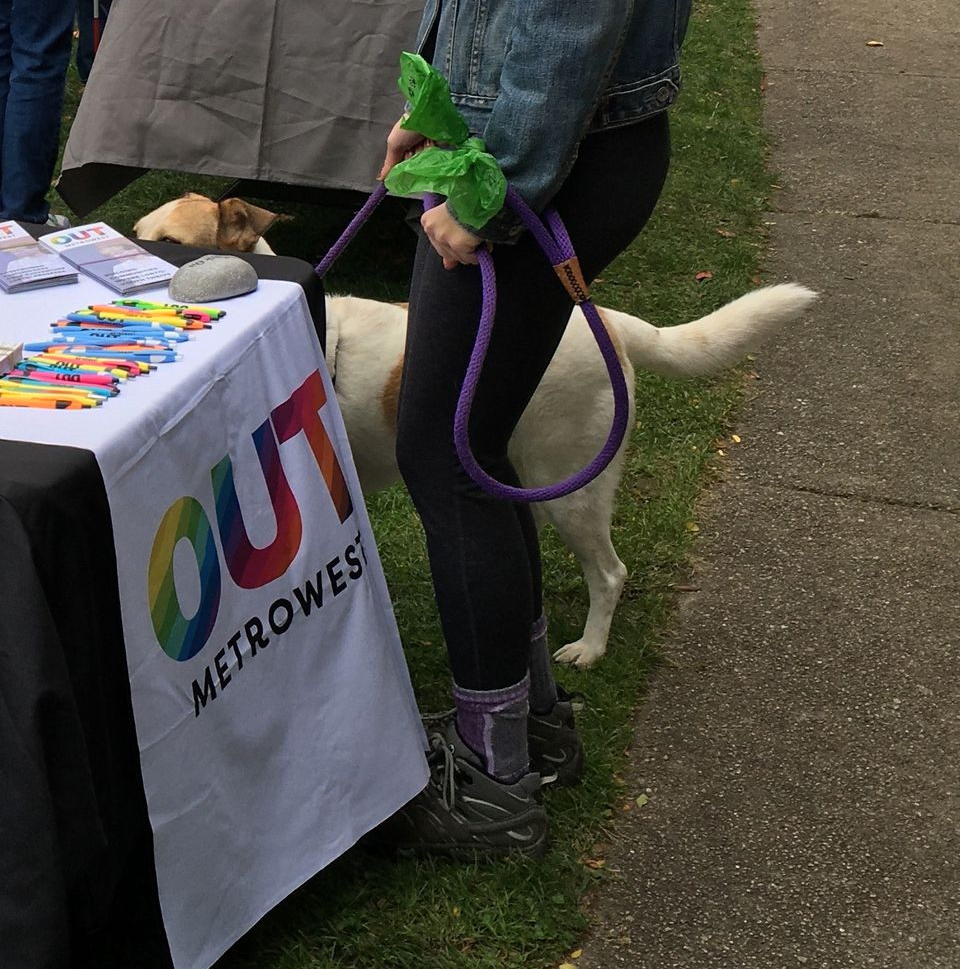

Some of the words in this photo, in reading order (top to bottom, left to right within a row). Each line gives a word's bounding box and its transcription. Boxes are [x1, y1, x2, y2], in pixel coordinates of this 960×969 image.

[50, 226, 105, 245] OUT
[147, 368, 354, 663] OUT
[191, 530, 368, 718] METROWEST
